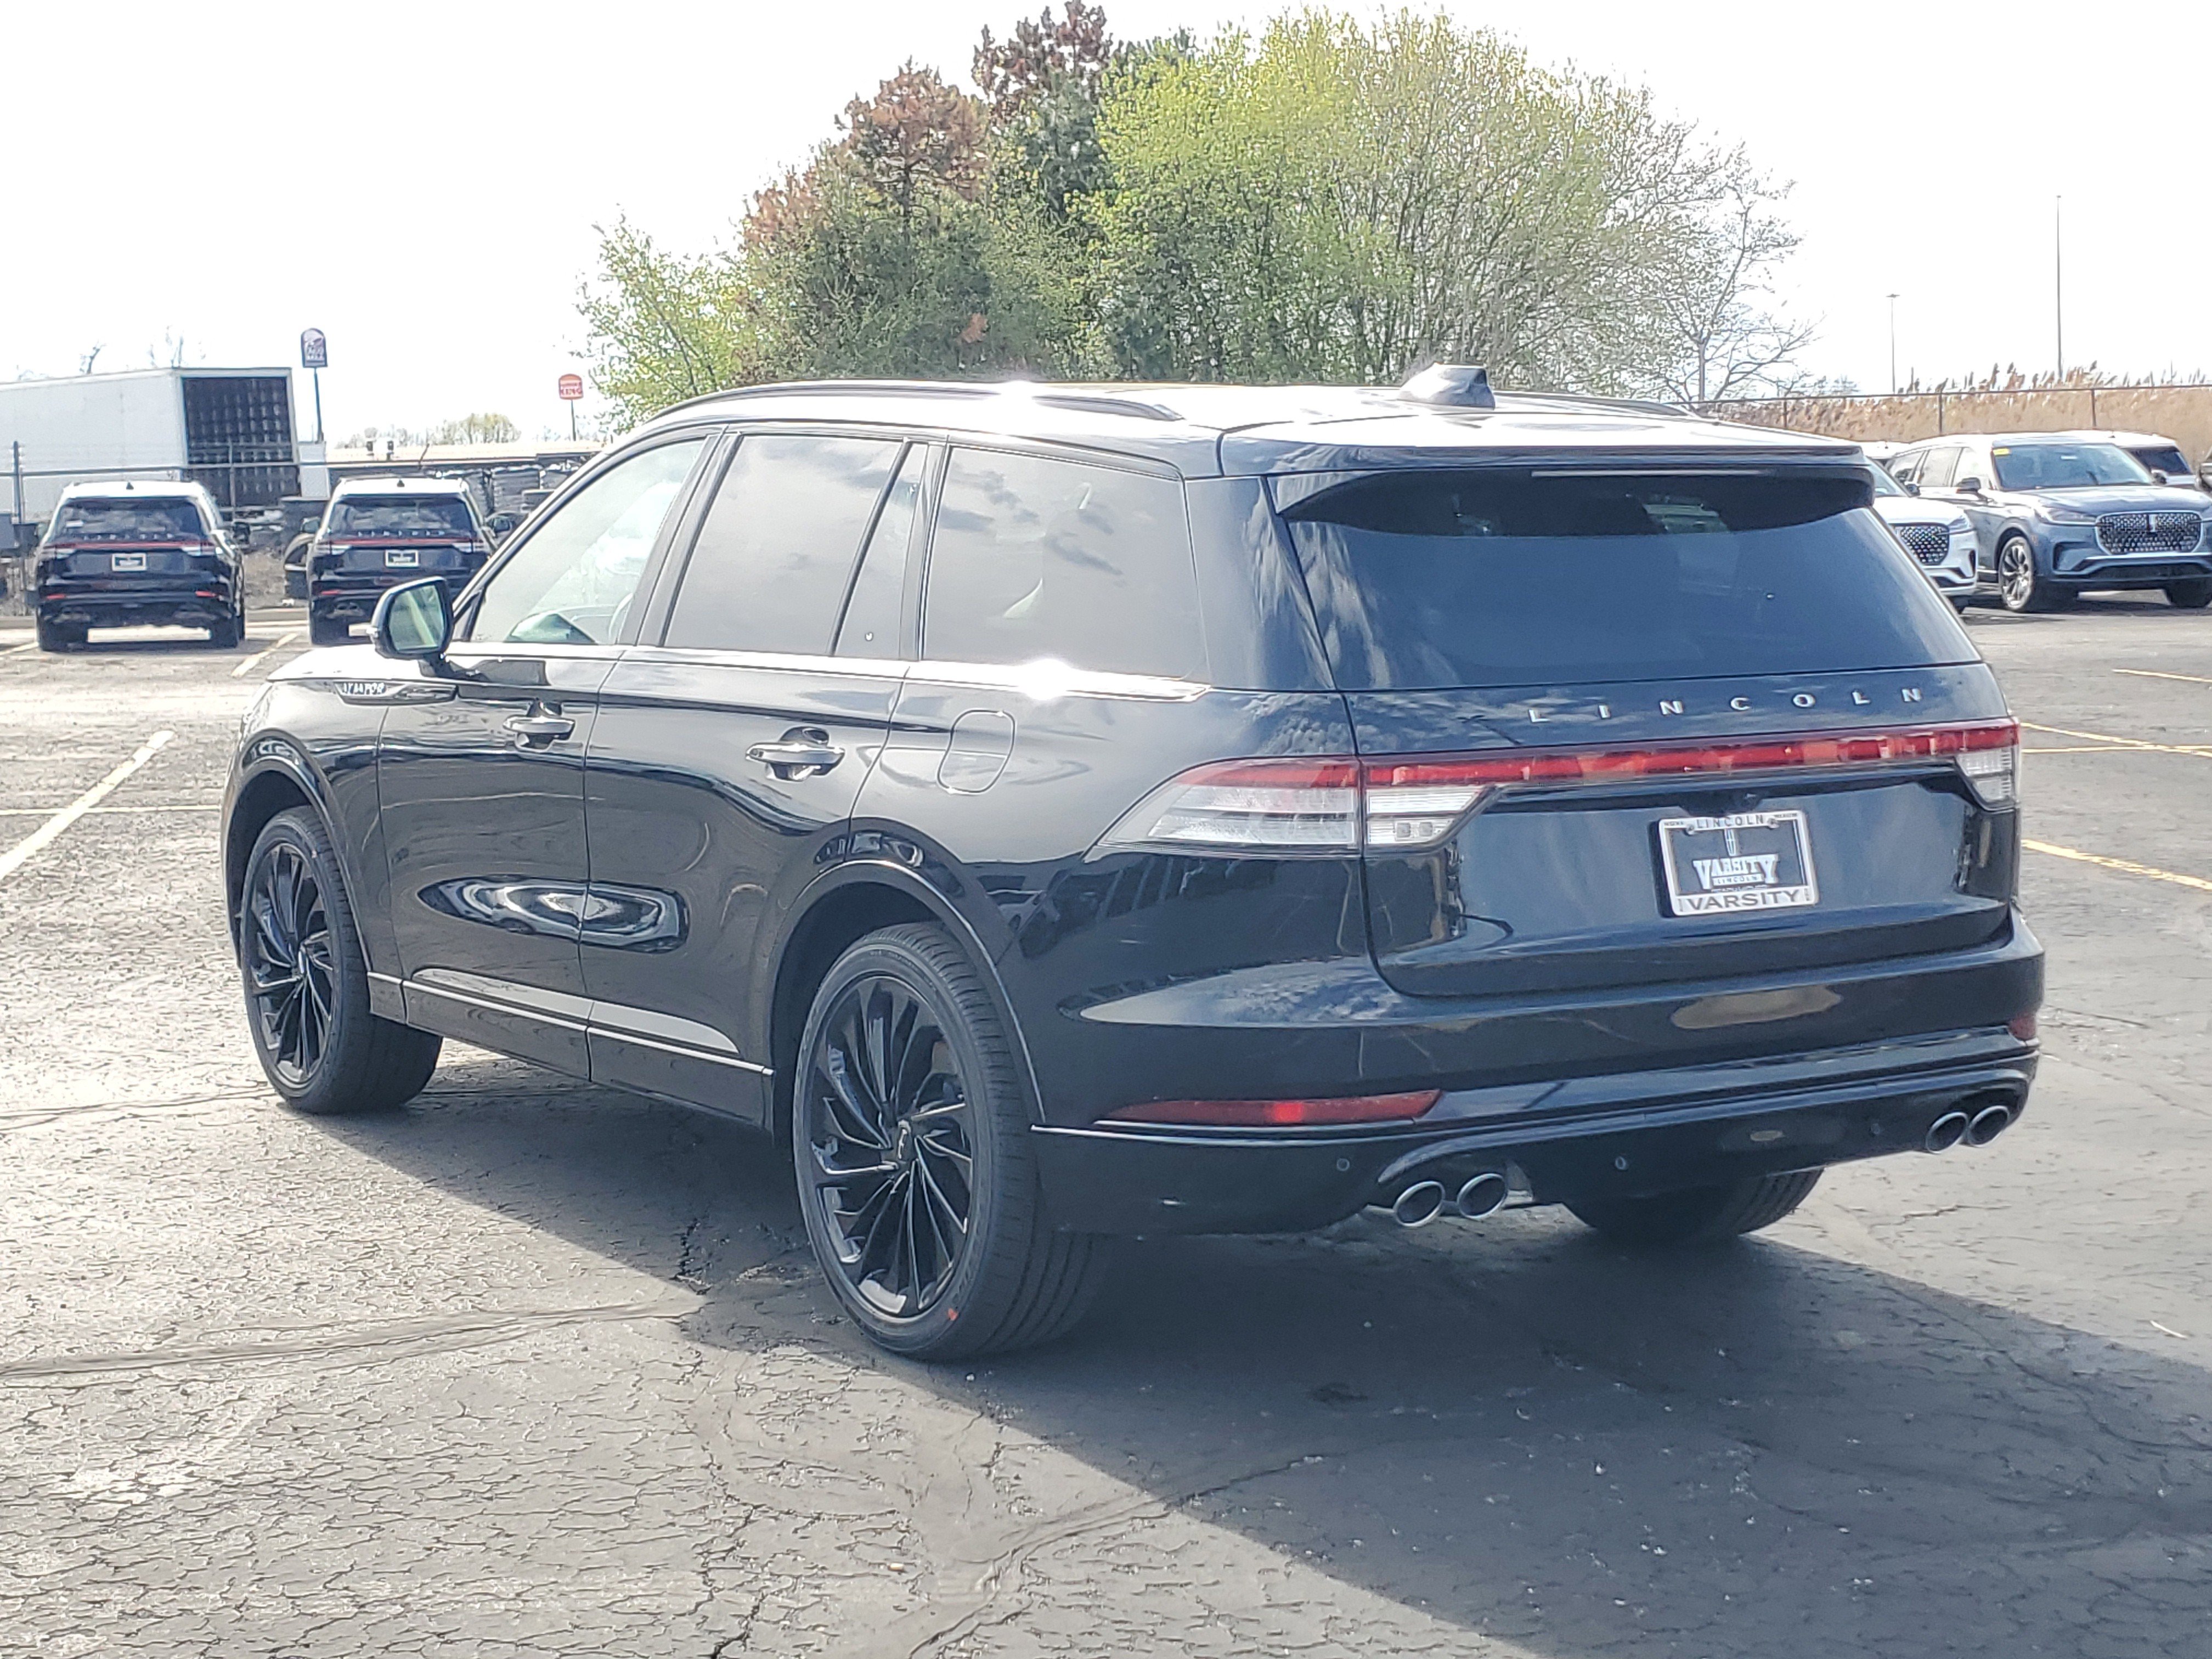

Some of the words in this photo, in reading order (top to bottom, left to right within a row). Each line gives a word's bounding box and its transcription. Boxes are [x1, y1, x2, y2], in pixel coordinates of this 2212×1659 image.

[1528, 687, 1922, 724] LINCOLN
[1696, 814, 1764, 829] LINCOLN
[1692, 854, 1778, 890] VARSITY
[1686, 889, 1799, 911] VARSITY
